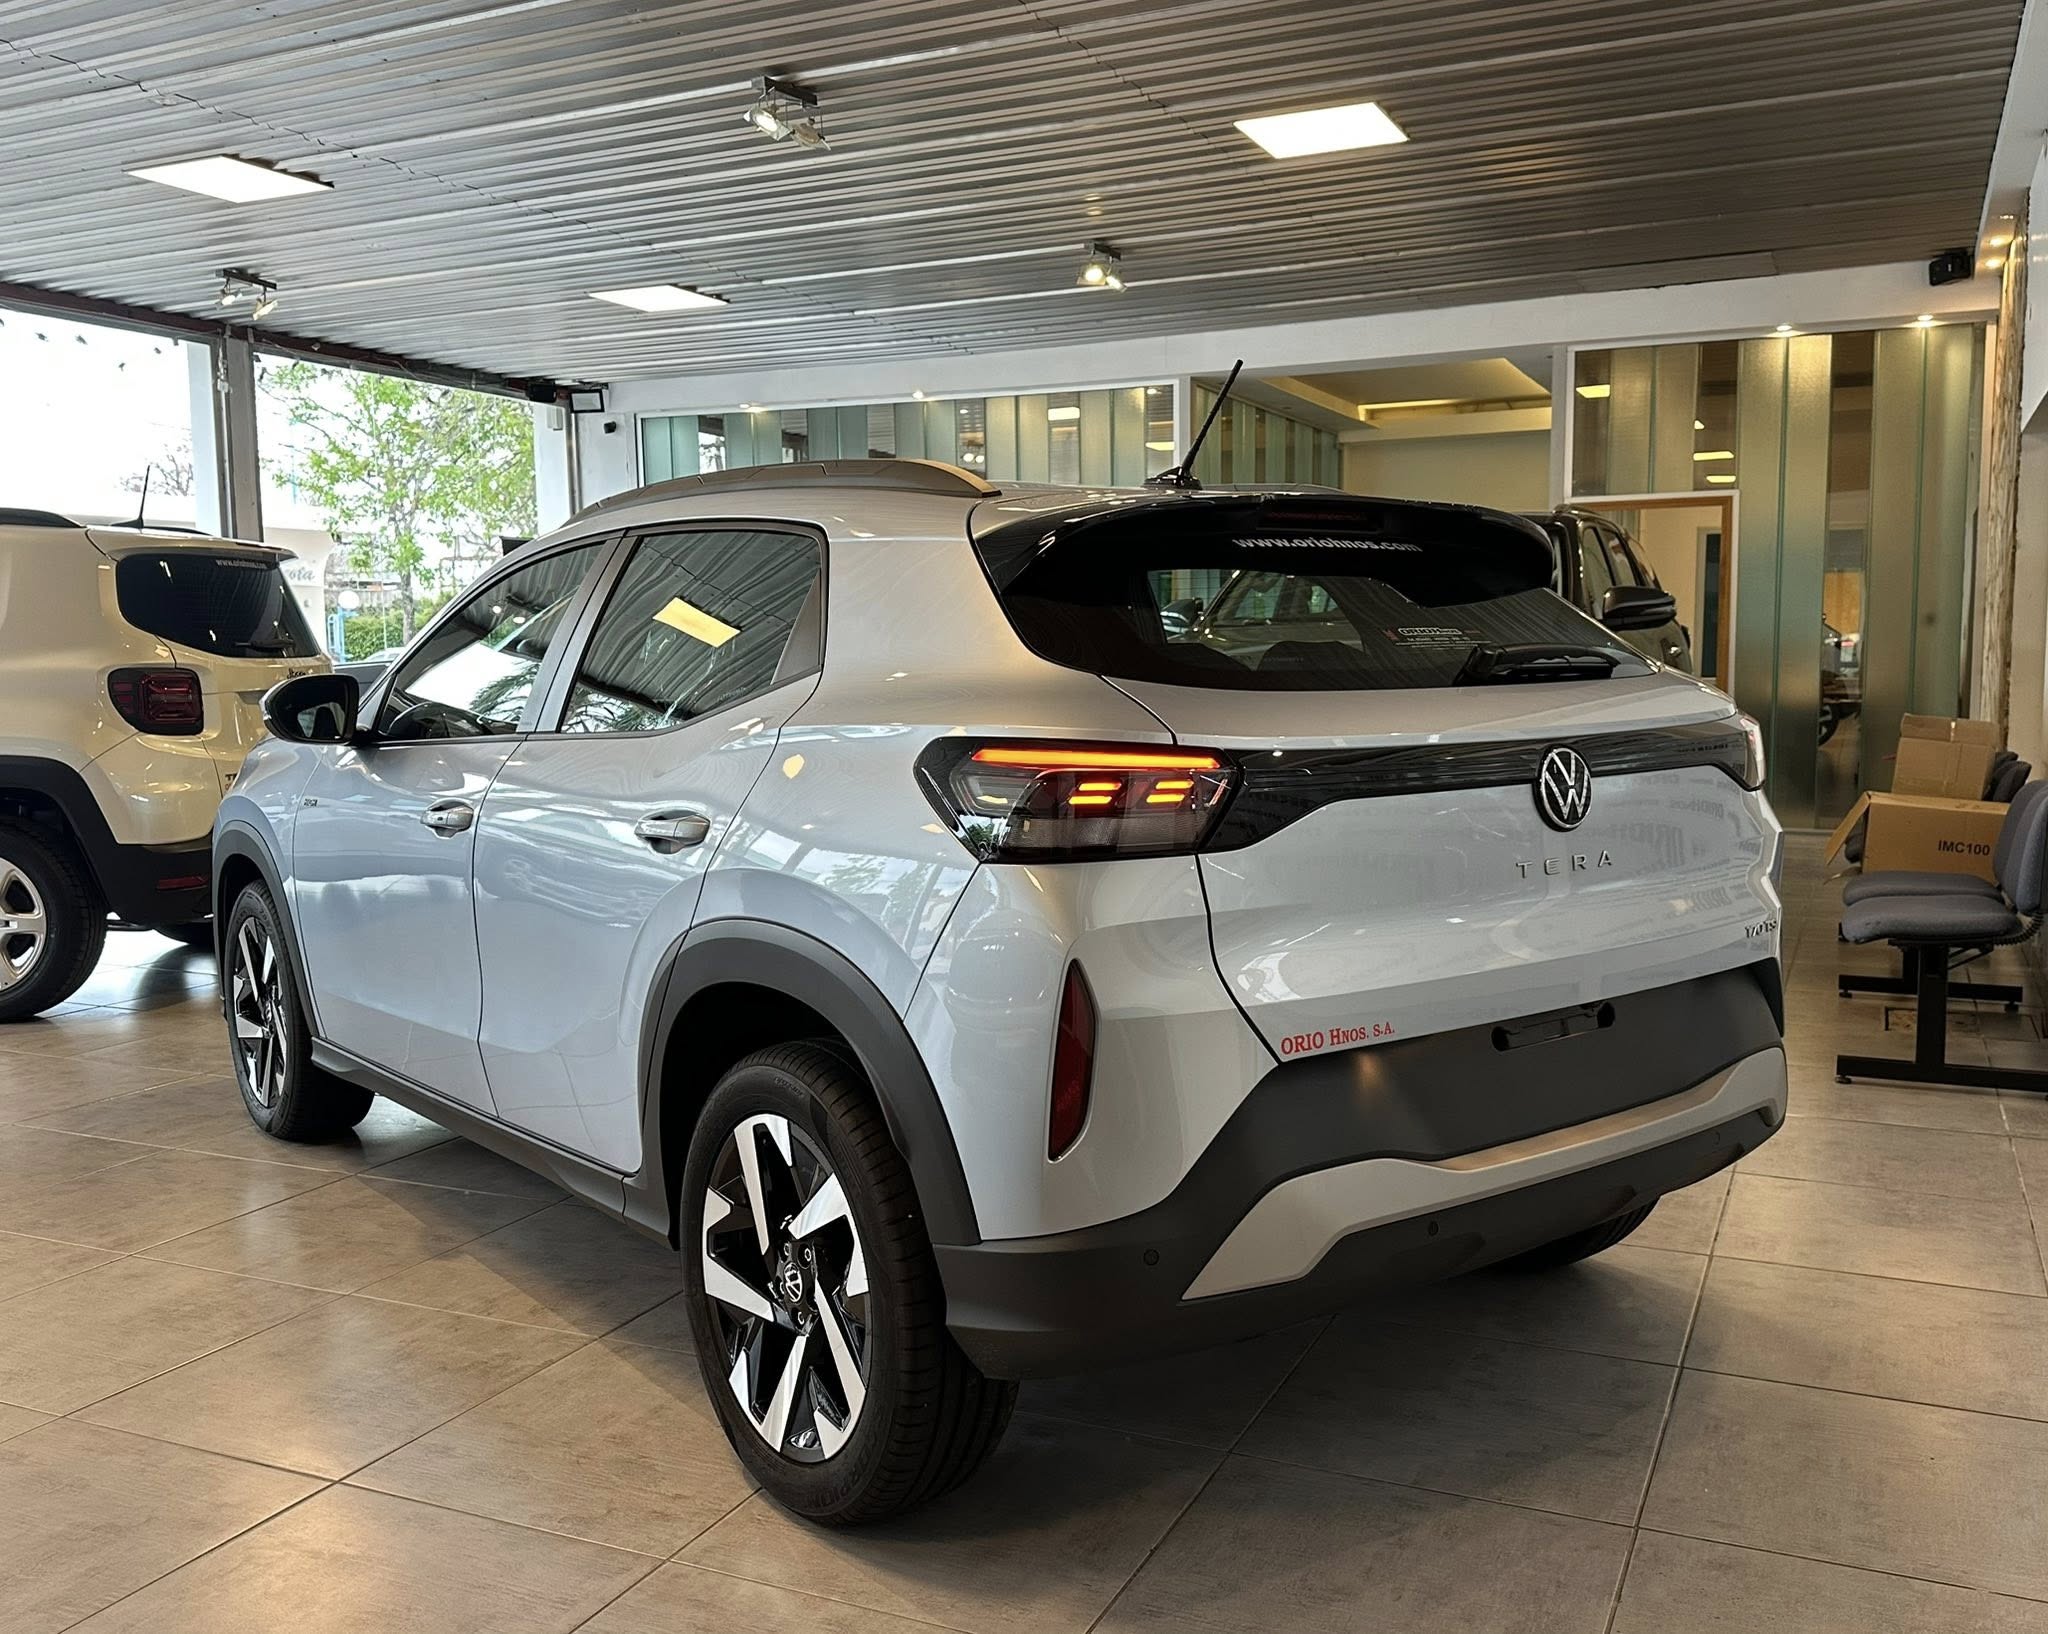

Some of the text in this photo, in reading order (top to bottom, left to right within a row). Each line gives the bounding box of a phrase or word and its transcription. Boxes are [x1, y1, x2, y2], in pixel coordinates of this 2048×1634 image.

[1232, 536, 1423, 552] www.oriohnos.com
[1937, 839, 1991, 857] IMC100
[1515, 850, 1613, 879] TERA
[1281, 1031, 1325, 1055] ORIO
[1373, 1021, 1395, 1037] S.A.
